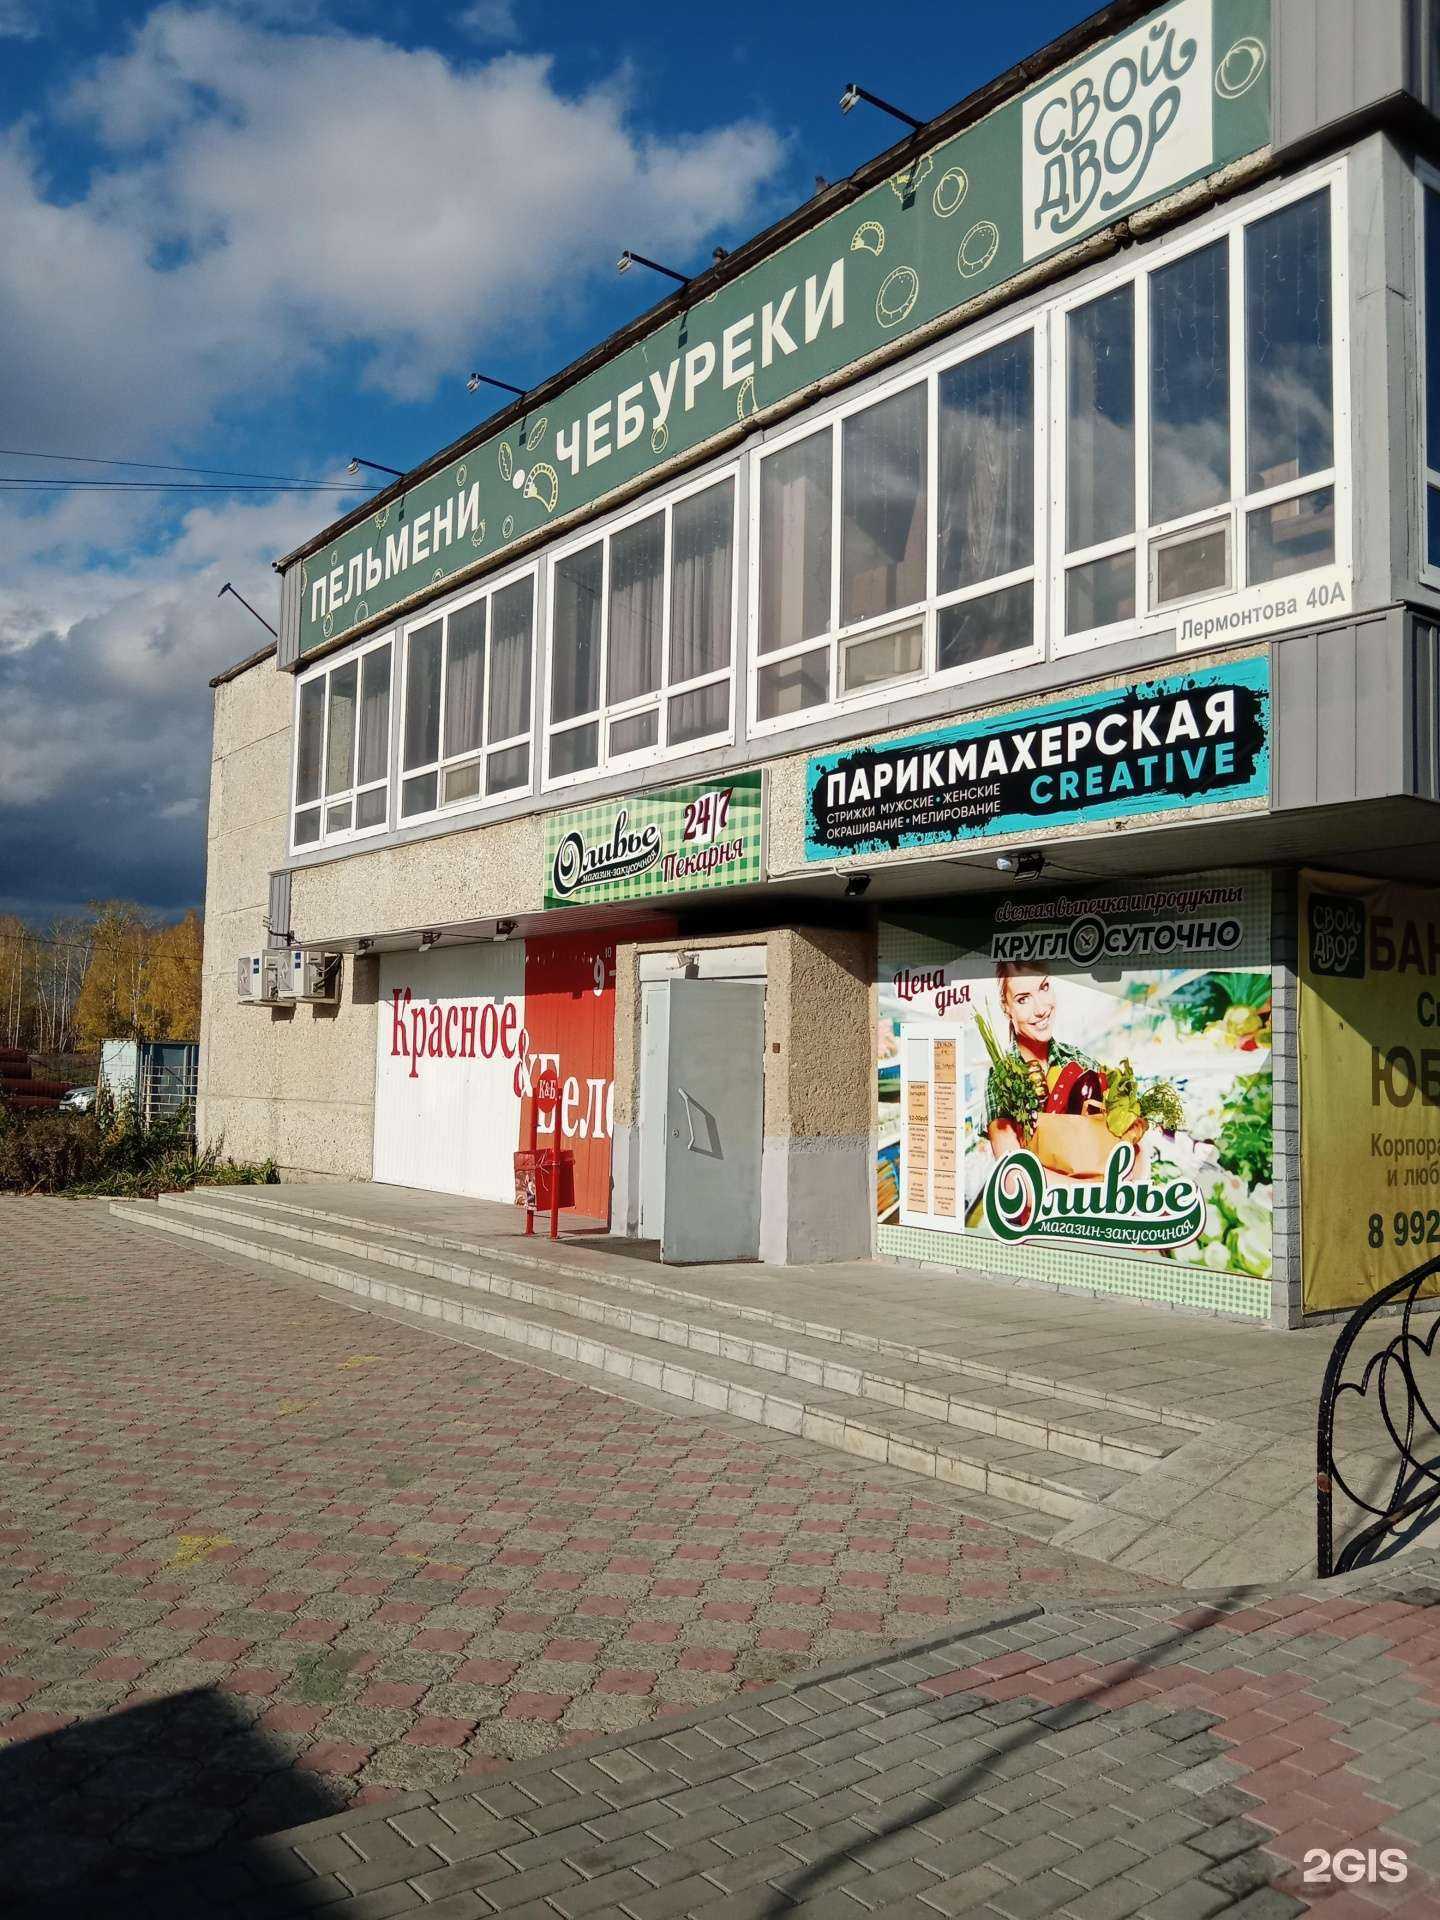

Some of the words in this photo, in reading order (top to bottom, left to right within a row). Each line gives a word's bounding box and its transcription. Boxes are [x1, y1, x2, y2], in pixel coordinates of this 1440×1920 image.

[1034, 21, 1197, 155] СВОЙ
[1034, 86, 1181, 234] ДВОР
[555, 257, 845, 476] ЧЕБУРЕКИ
[310, 481, 481, 623] ПЕЛЬМЕНИ
[1181, 597, 1297, 640] Лермонтова
[1306, 581, 1346, 609] 40А
[826, 689, 1236, 807] ПАРИКМАХЕРСКАЯ
[1030, 741, 1236, 805] CREATIVE
[682, 786, 734, 843] 24/7
[826, 806, 876, 825] СТРИЖКИ
[880, 794, 935, 815] МУЖСКИЕ
[942, 783, 1001, 804] ЖЕНСКИЕ
[826, 816, 904, 840] ОКРАШИВАНИЕ
[912, 800, 1001, 825] МЕЛИРОВАНИЕ
[554, 809, 660, 896] Оливье
[661, 836, 744, 883] Пекарня
[1144, 886, 1245, 916] продукты
[992, 916, 1241, 963] КРУГЛОСУТОЧНО
[1312, 932, 1358, 973] ДВОР
[893, 968, 946, 1002] Цена
[934, 984, 971, 1017] дня
[390, 985, 517, 1078] Красное
[986, 1144, 1198, 1241] Оливье
[1387, 1168, 1399, 1187] и
[1403, 1159, 1440, 1186] люб
[1038, 1219, 1195, 1246] магазин-закусочная
[1368, 1212, 1384, 1249] 8
[1393, 1208, 1440, 1247] 992
